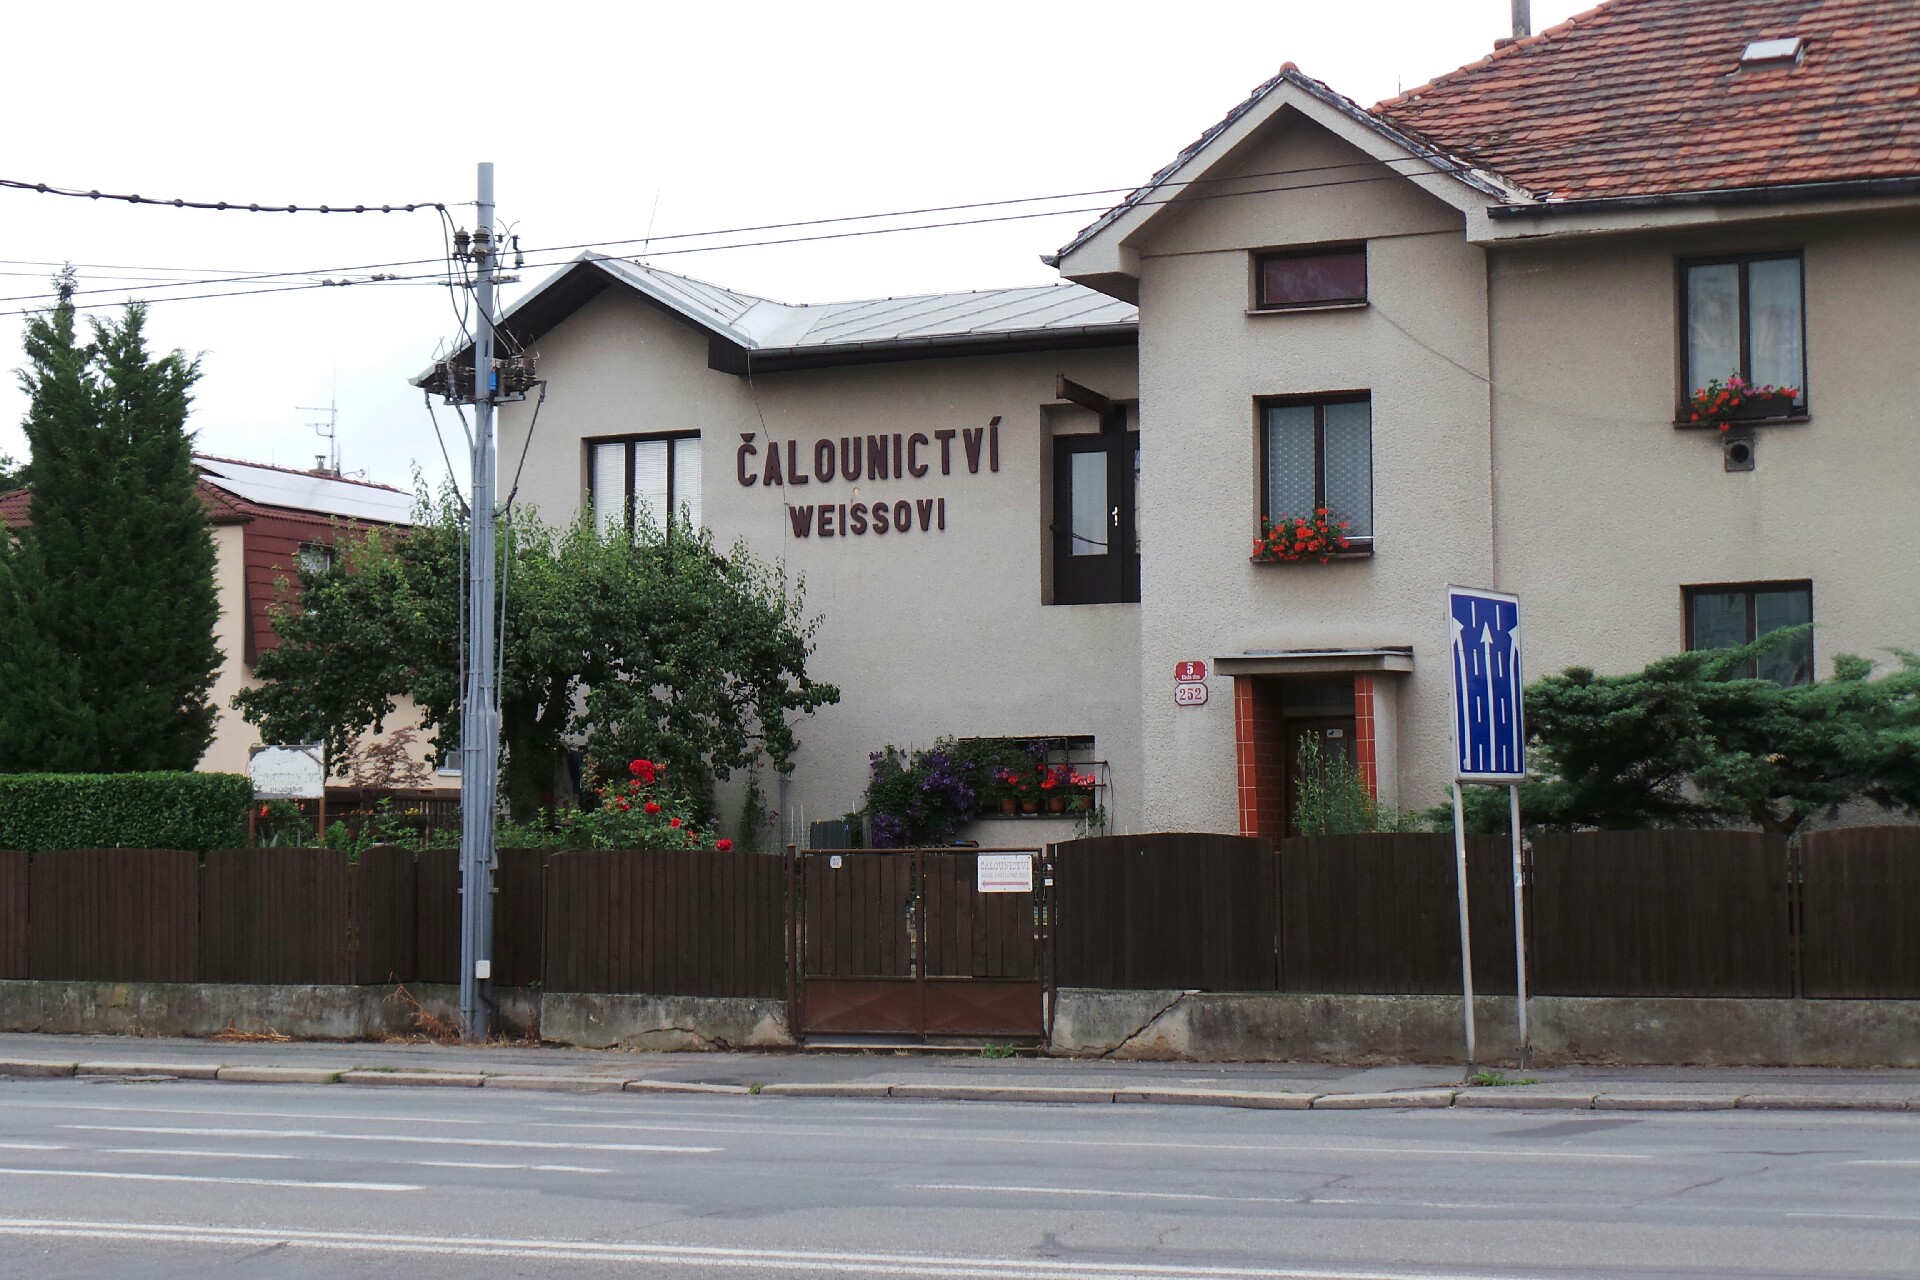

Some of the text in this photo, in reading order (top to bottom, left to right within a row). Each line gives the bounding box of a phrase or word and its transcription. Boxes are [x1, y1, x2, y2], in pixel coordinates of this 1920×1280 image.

[736, 416, 1001, 487] ČALOUNICTVÍ
[789, 497, 945, 538] WEISSOVI
[1186, 662, 1194, 674] 5
[1180, 688, 1201, 700] 252
